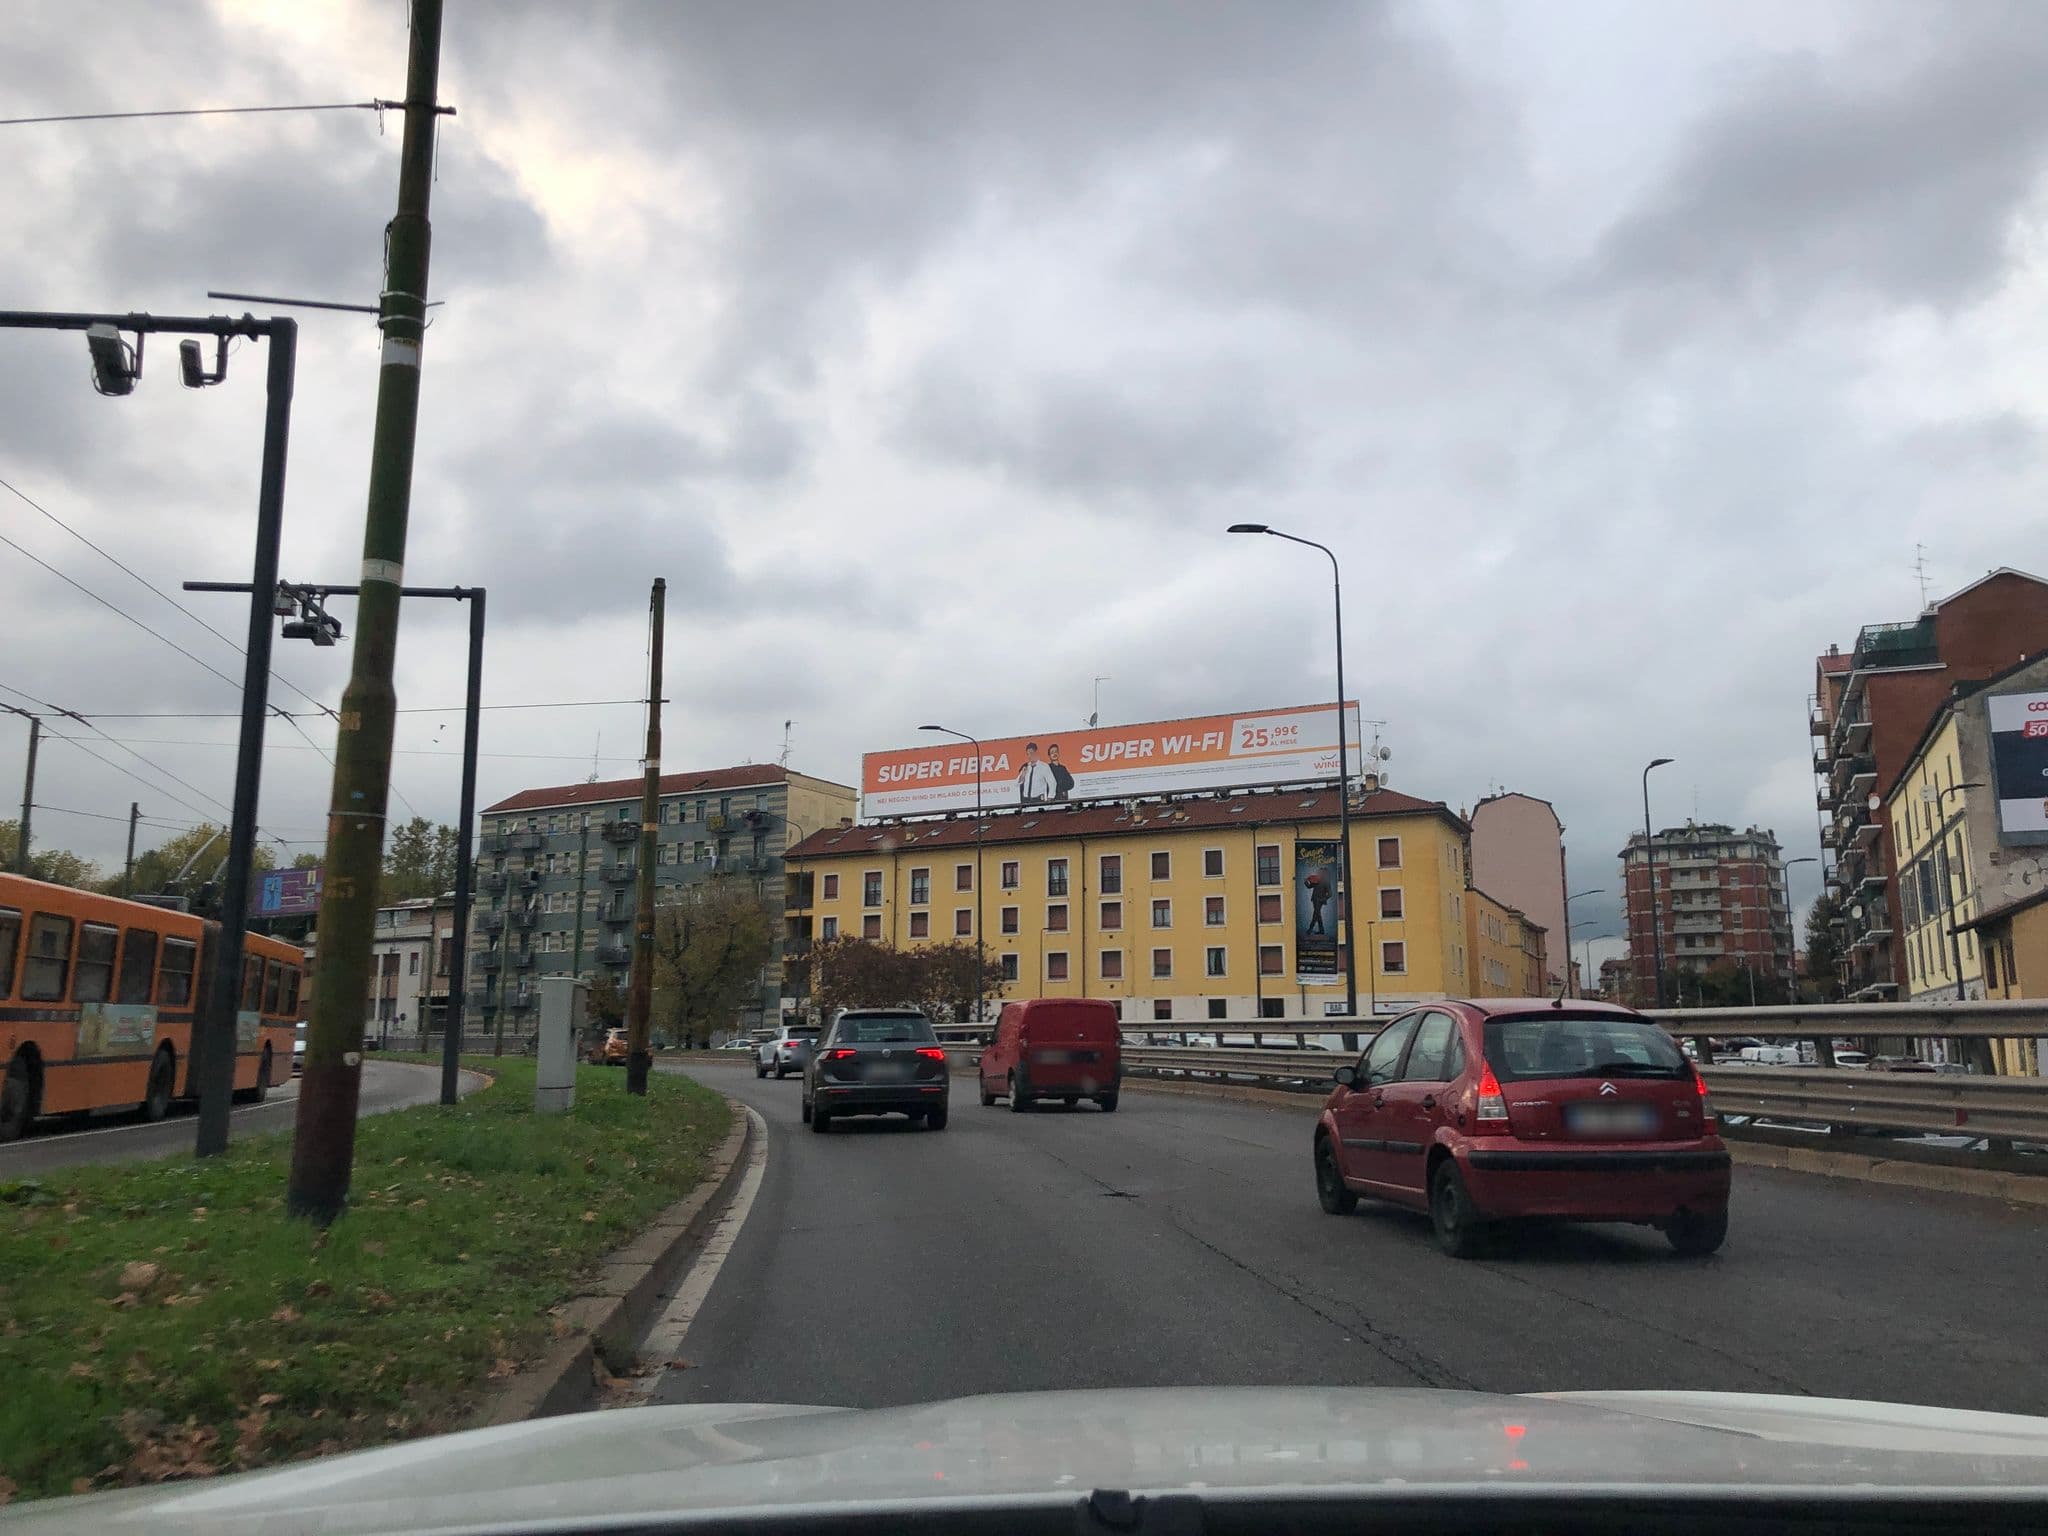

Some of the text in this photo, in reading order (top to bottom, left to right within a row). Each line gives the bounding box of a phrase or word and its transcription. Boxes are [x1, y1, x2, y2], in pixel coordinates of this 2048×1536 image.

[2028, 702, 2048, 712] CO
[1080, 732, 1224, 763] SUPER WI-FI
[878, 754, 1010, 783] SUPER FIBRA
[937, 791, 960, 799] MILANO
